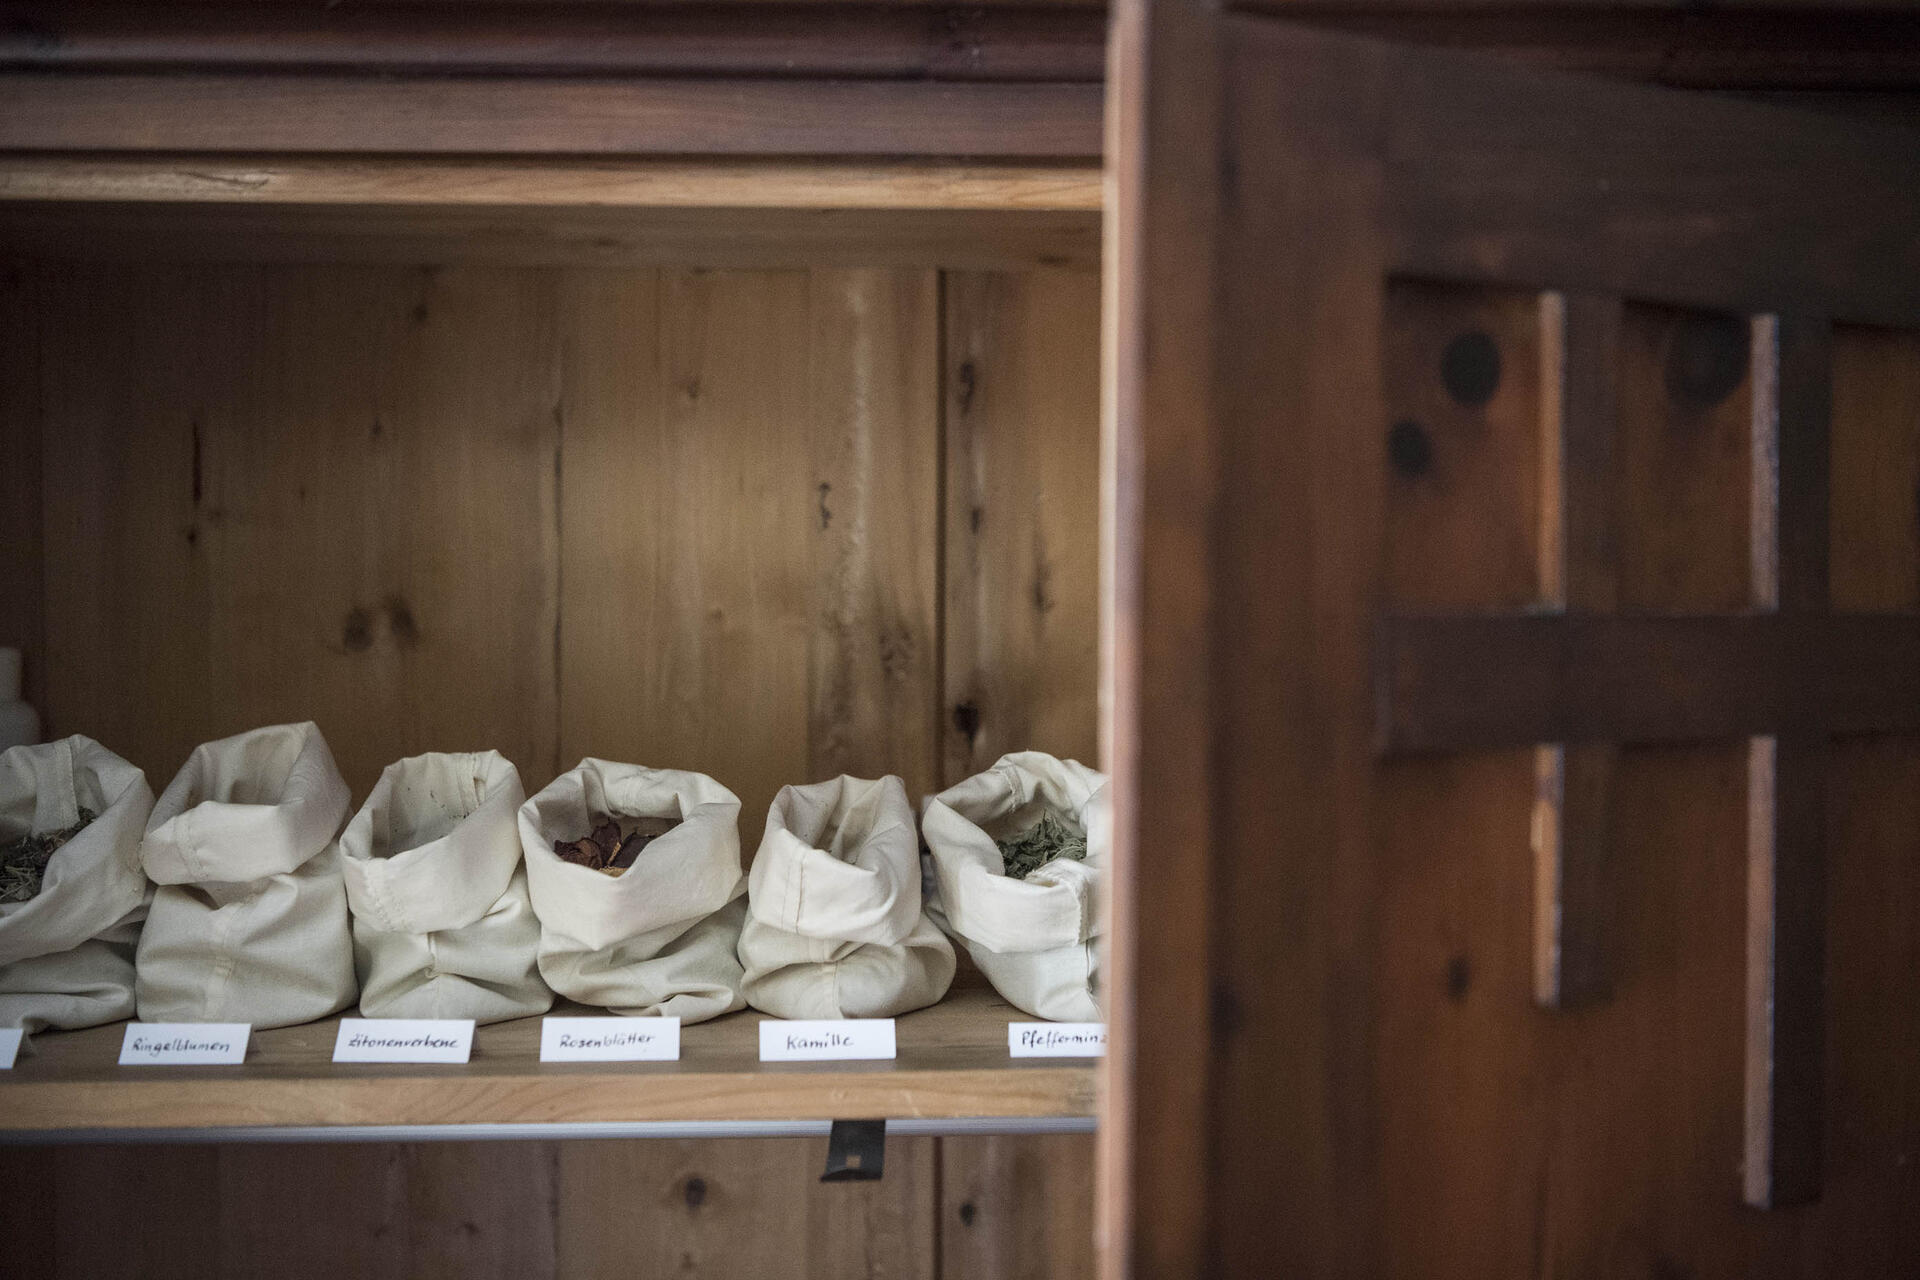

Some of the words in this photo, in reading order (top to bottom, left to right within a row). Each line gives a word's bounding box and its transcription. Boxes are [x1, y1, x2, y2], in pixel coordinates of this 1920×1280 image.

[132, 1037, 230, 1057] Ringelblumen
[560, 1033, 654, 1048] Rosenblätter
[787, 1032, 854, 1050] Kamille
